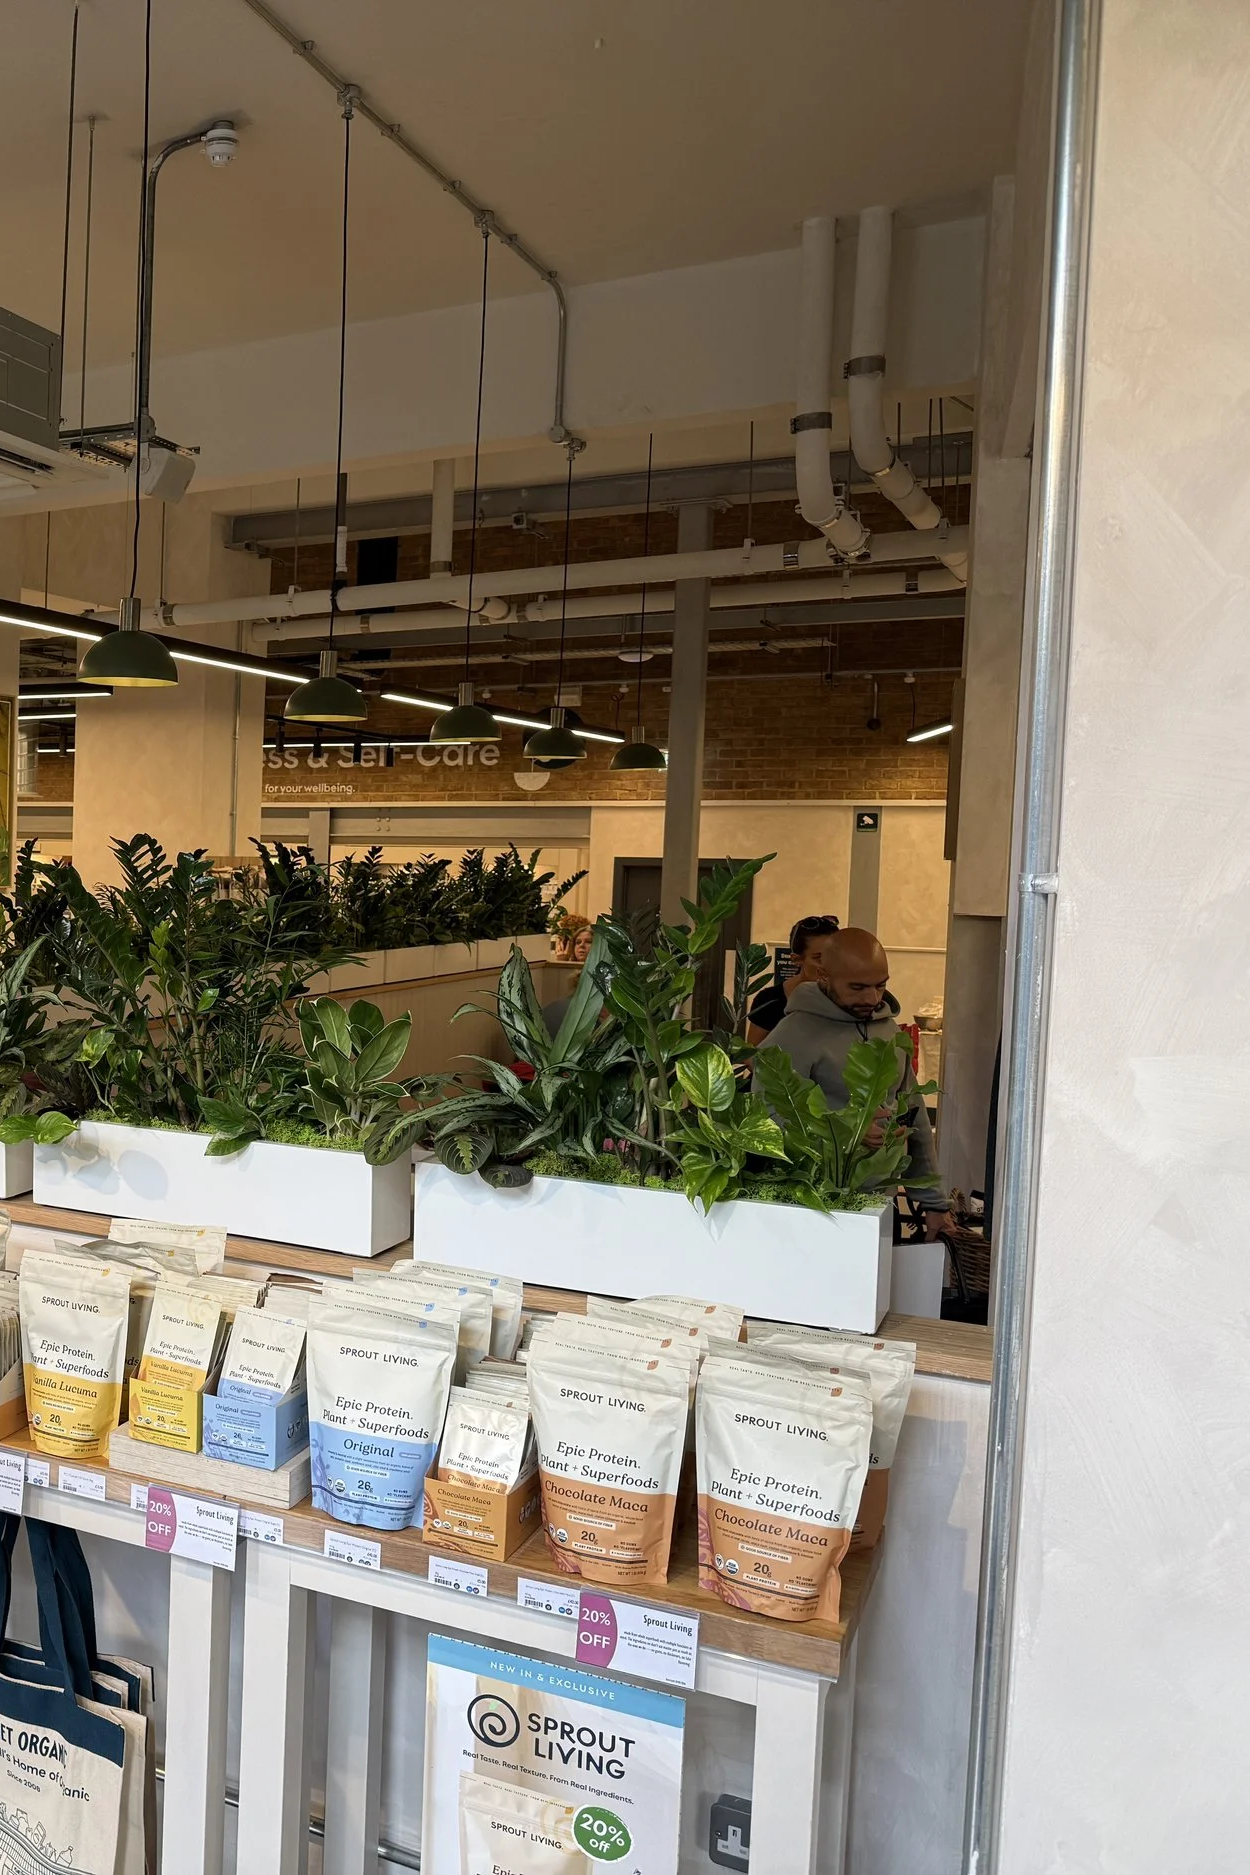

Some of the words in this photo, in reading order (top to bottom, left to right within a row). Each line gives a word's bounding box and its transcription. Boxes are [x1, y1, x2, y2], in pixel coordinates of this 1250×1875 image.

[262, 748, 299, 769] ess
[265, 784, 278, 793] for
[280, 785, 302, 794] your
[304, 783, 356, 793] wellbeing.
[42, 1296, 69, 1308] SPROUT
[40, 1339, 60, 1354] Epic
[340, 1347, 380, 1360] SPROUT
[150, 1348, 164, 1357] Plant
[168, 1352, 201, 1366] Superfoods
[56, 1359, 109, 1378] Superfoods
[151, 1361, 168, 1370] Vanilla
[170, 1367, 193, 1377] Lucuma
[230, 1371, 245, 1380] Plant
[248, 1376, 281, 1389] Superfoods
[59, 1382, 98, 1398] Lucuma
[141, 1387, 159, 1396] Vanilla
[161, 1391, 183, 1401] Lucuma
[230, 1385, 251, 1396] Original
[560, 1389, 603, 1405] SPROUT
[215, 1404, 239, 1414] Original
[335, 1396, 362, 1412] Epic
[365, 1402, 413, 1420] Protein.
[323, 1409, 347, 1425] Plant
[357, 1419, 429, 1439] Superfoods
[460, 1424, 485, 1435] SPROUT
[734, 1414, 781, 1431] SPROUT
[787, 1424, 829, 1442] LIVING.
[343, 1439, 394, 1458] Original
[458, 1452, 472, 1463] Epic
[557, 1442, 585, 1458] Epic
[590, 1449, 640, 1469] Protein.
[7, 1460, 21, 1472] Living
[447, 1458, 463, 1468] Plant
[469, 1465, 508, 1480] Superfoods
[541, 1454, 569, 1472] Plant
[580, 1465, 659, 1489] Superfoods
[357, 1480, 373, 1493] 26g
[447, 1473, 483, 1488] Chocolate
[485, 1484, 500, 1493] Maca
[730, 1468, 760, 1486] Epic
[764, 1476, 822, 1500] Protein.
[437, 1488, 469, 1502] Chocolate
[470, 1495, 491, 1505] Maca
[545, 1480, 606, 1505] Chocolate
[609, 1497, 648, 1512] Maca
[711, 1481, 742, 1500] Plant
[756, 1494, 840, 1522] Superfoods
[150, 1501, 171, 1516] 20%
[197, 1506, 215, 1518] Sprout
[216, 1512, 234, 1525] Living
[148, 1521, 171, 1536] OFF
[714, 1509, 782, 1537] Chocolate
[786, 1528, 828, 1547] Maca
[581, 1531, 598, 1544] 20g
[754, 1562, 772, 1578] 20g
[759, 1578, 776, 1586] PROTEIN
[582, 1608, 611, 1626] 20%
[643, 1614, 668, 1628] Sprout
[670, 1621, 692, 1636] Living
[579, 1632, 610, 1648] OFF
[490, 1661, 517, 1673] NEW
[520, 1669, 532, 1678] IN
[537, 1672, 544, 1682] &
[550, 1676, 615, 1700] EXCLUSIVE
[527, 1713, 636, 1758] SPROUT
[534, 1738, 626, 1779] LIVING
[7, 1769, 22, 1784] Since
[13, 1756, 46, 1778] Home
[49, 1772, 60, 1782] of
[463, 1749, 479, 1759] Real
[480, 1754, 501, 1766] Taste.
[502, 1760, 518, 1770] Real
[520, 1765, 548, 1780] Texture.
[549, 1775, 569, 1785] From
[570, 1780, 587, 1791] Real
[588, 1786, 634, 1805] Ingredients.
[490, 1822, 527, 1838] SPROUT
[579, 1813, 625, 1847] 20%
[589, 1838, 610, 1853] off
